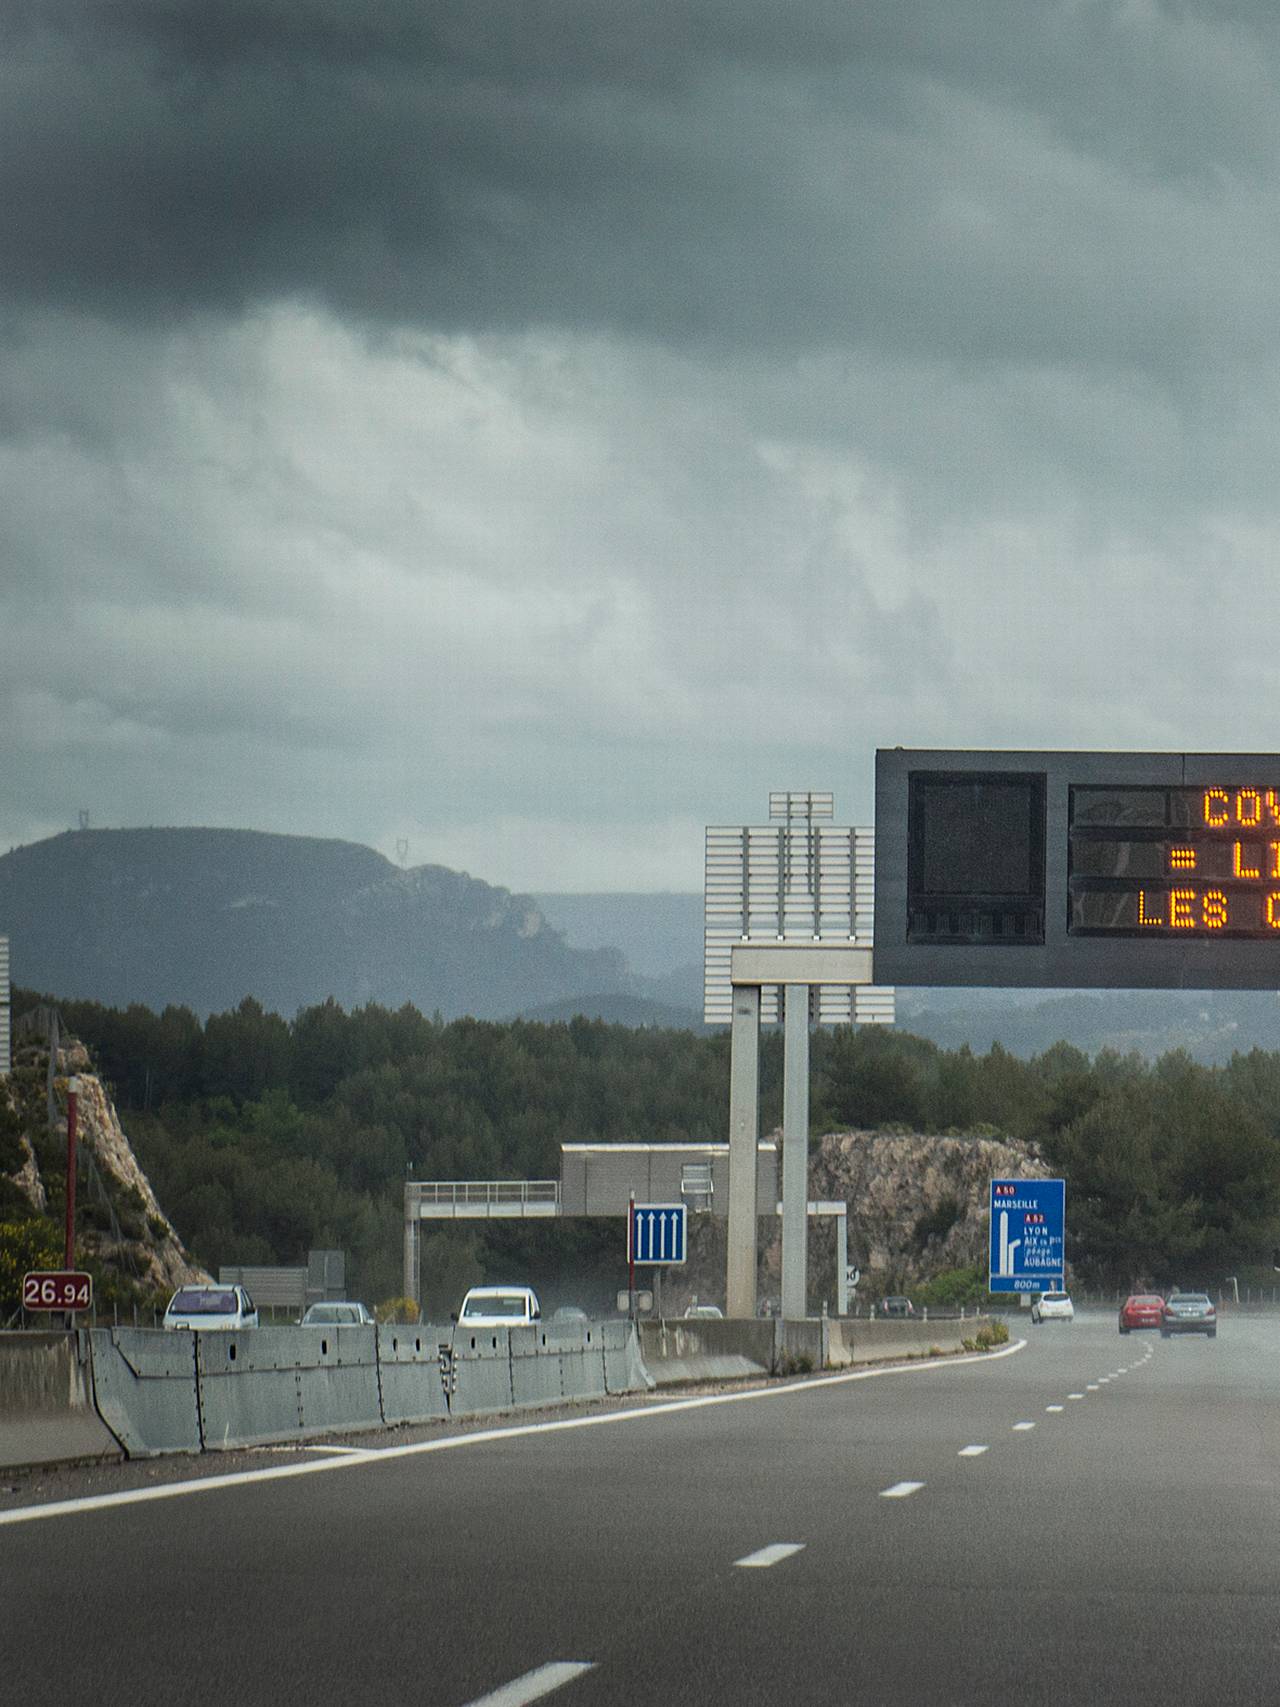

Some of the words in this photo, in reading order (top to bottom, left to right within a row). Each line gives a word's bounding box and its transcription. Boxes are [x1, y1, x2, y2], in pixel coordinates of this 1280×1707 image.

[1138, 888, 1227, 928] LES
[994, 1199, 1039, 1209] MARSEILLE
[1024, 1226, 1048, 1236] LYON
[1024, 1257, 1062, 1267] AUBAGNE
[25, 1279, 89, 1304] 26.94
